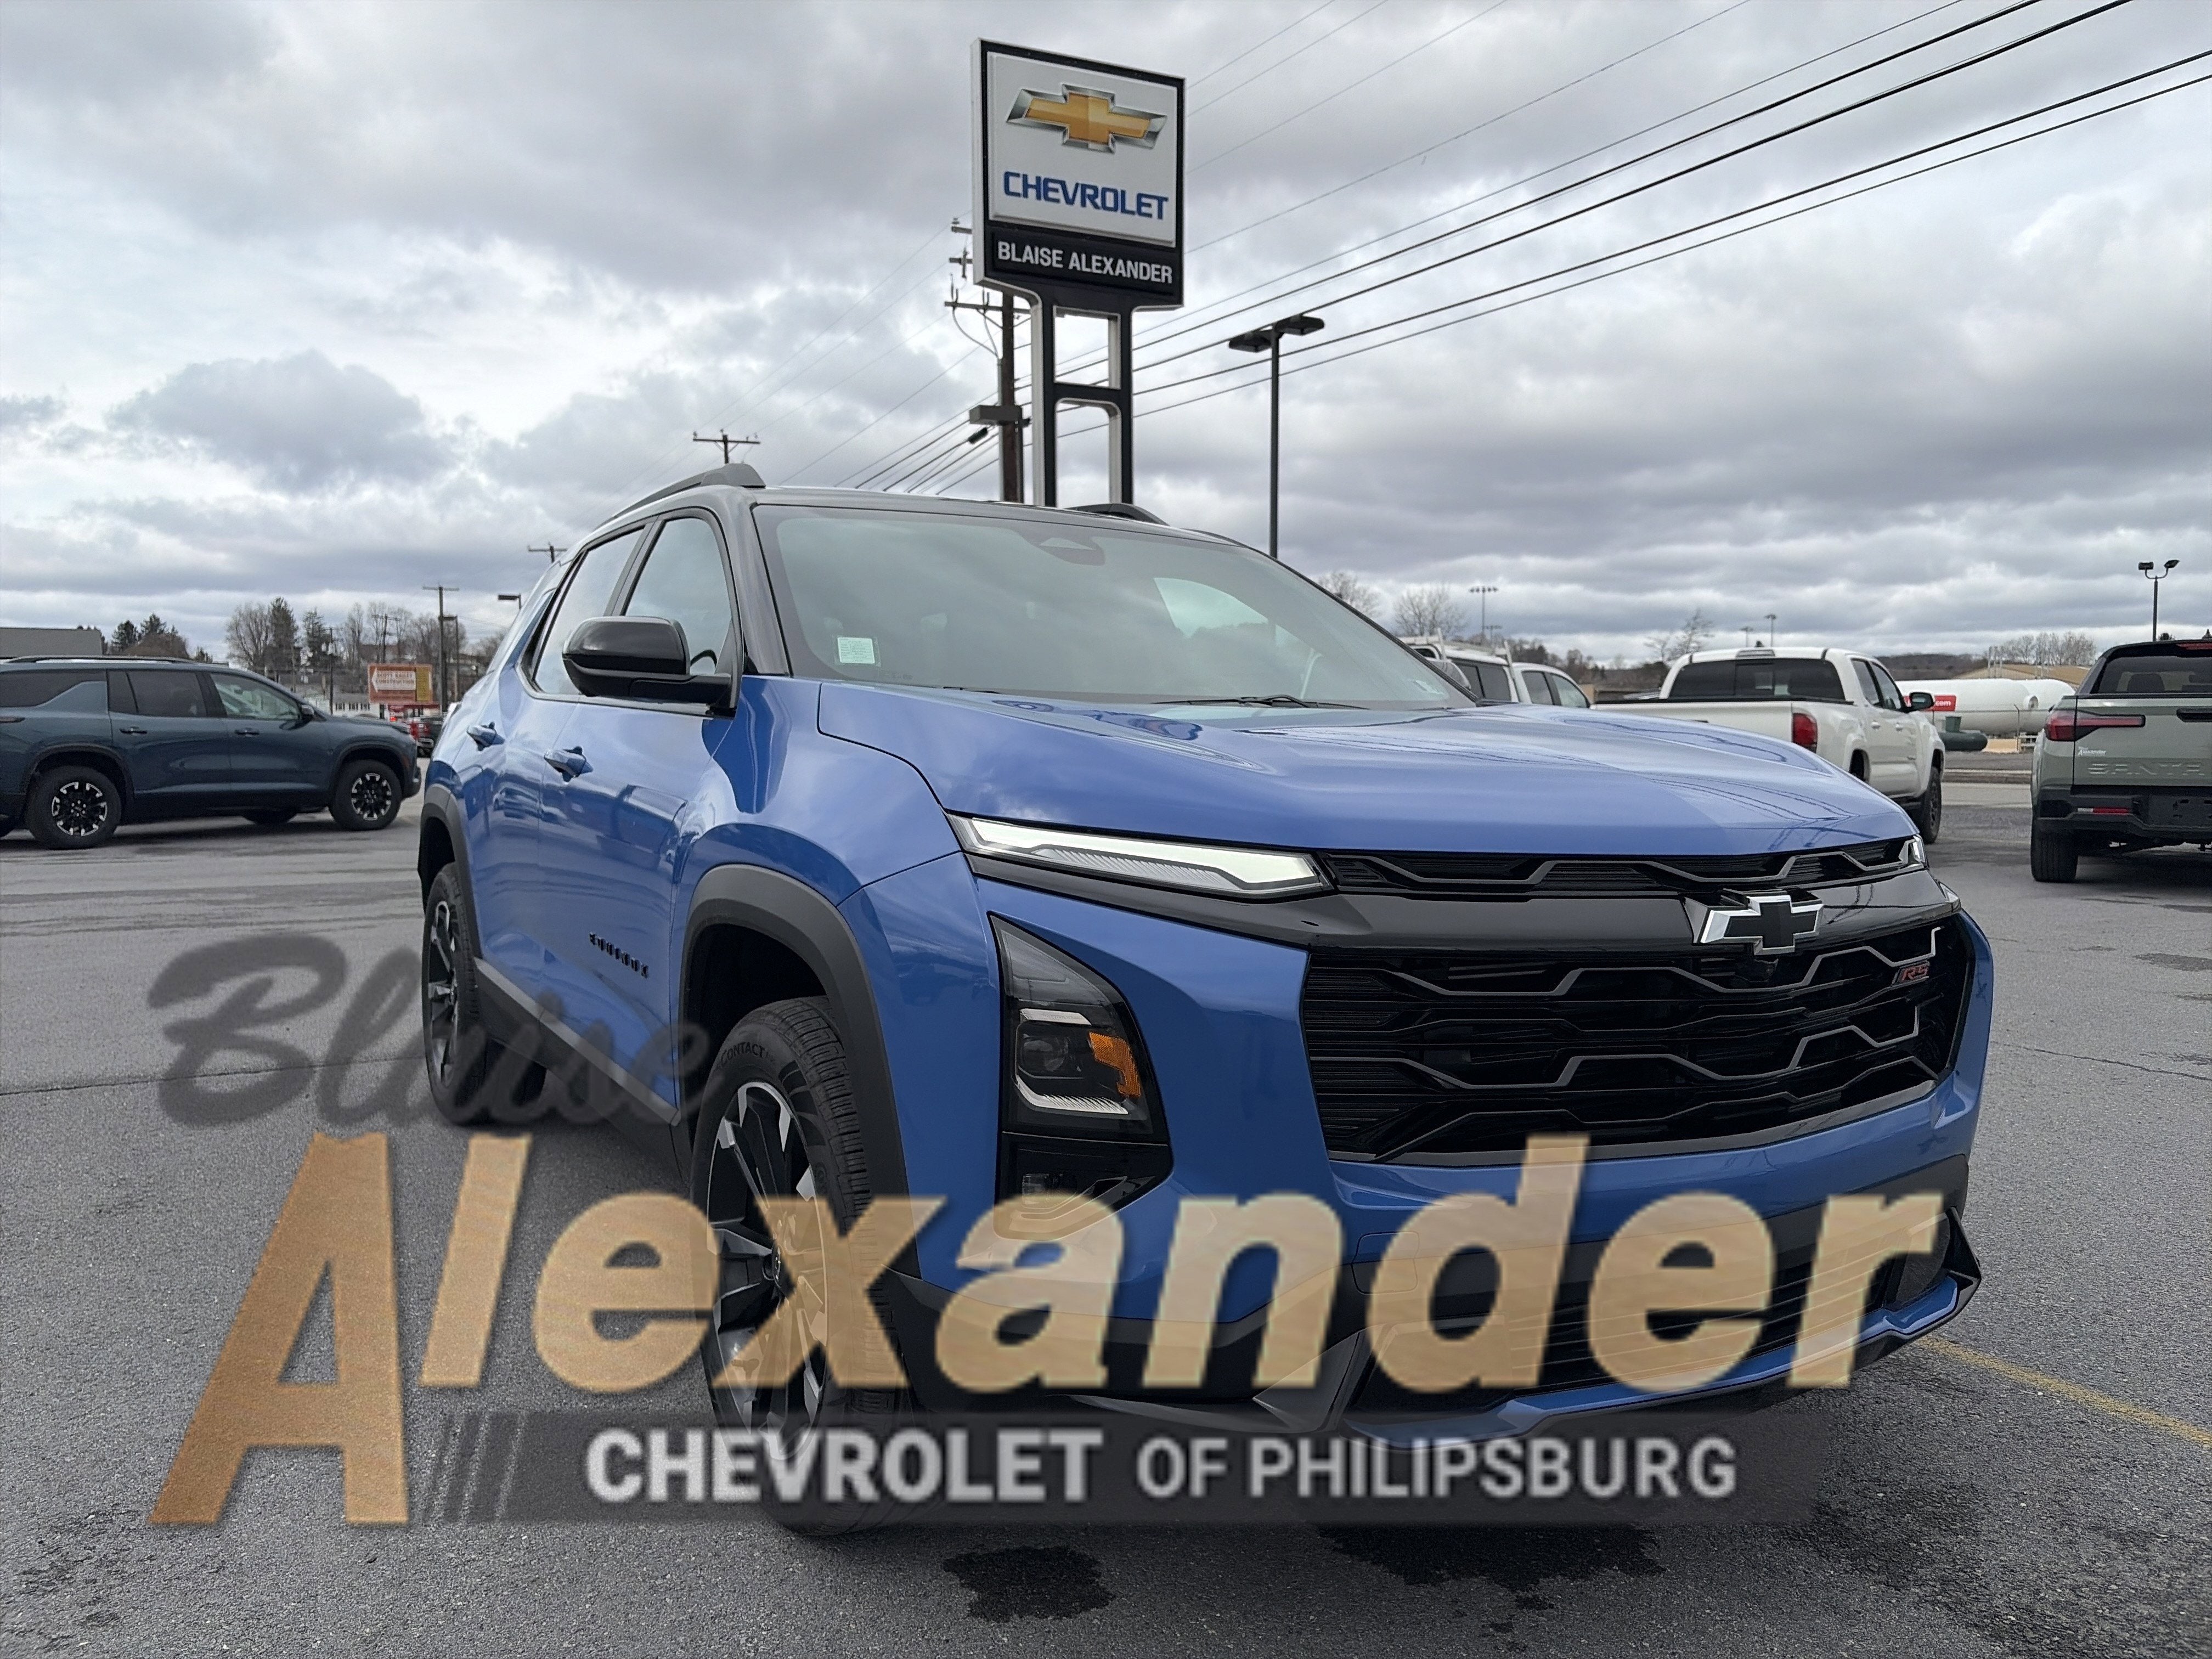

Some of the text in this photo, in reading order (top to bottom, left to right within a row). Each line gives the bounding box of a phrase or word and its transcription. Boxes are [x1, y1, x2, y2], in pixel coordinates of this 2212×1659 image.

[1003, 171, 1169, 219] CHEVROLET
[997, 240, 1173, 284] BLAISE ALEXANDER
[1901, 966, 1928, 981] RS
[720, 1042, 765, 1064] CONTACT
